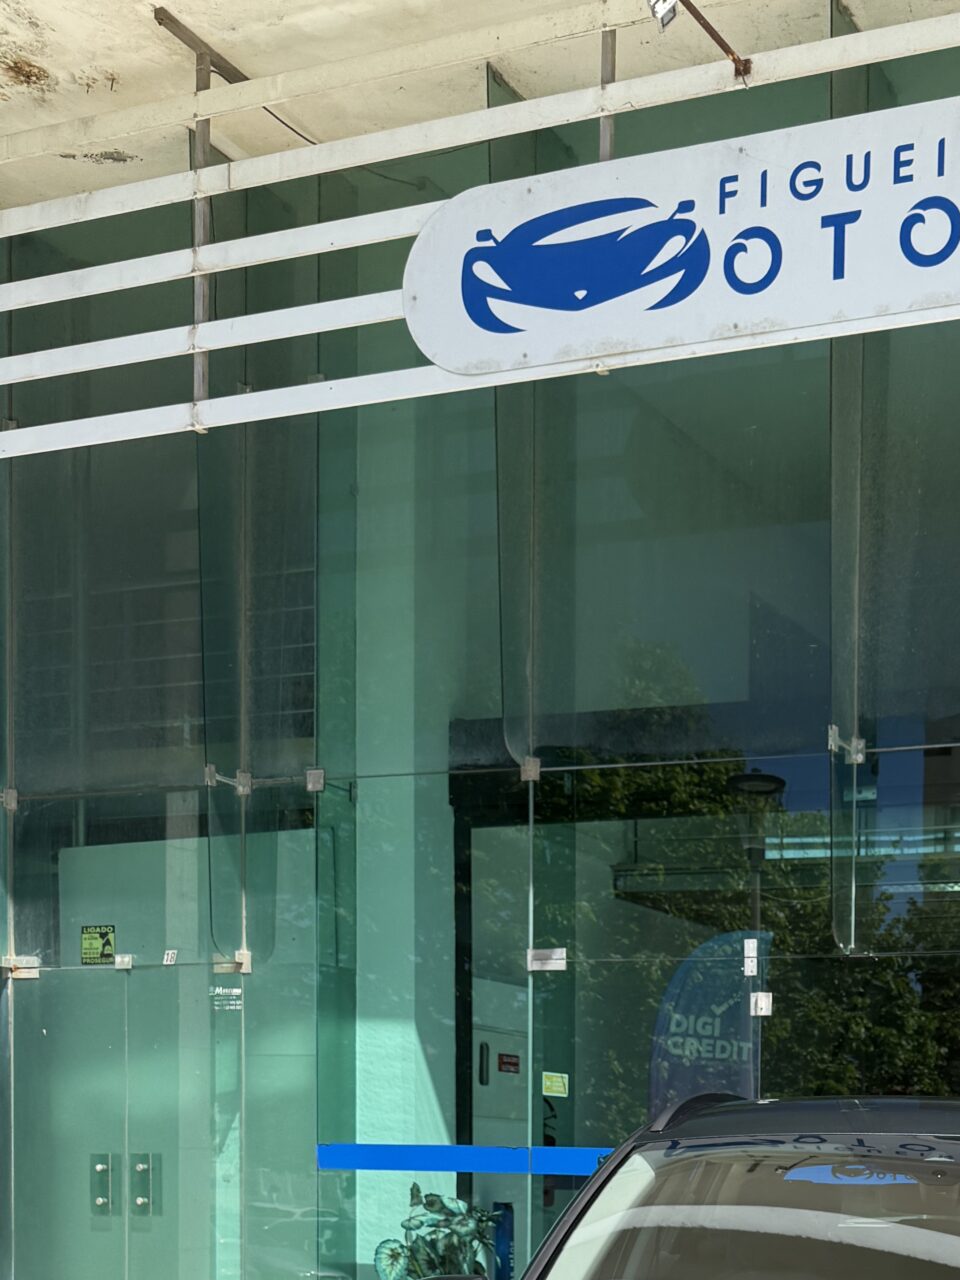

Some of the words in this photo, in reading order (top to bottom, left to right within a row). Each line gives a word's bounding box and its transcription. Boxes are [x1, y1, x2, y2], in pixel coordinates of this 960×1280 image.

[83, 926, 113, 934] LIGADO
[165, 951, 176, 963] 18
[669, 1012, 721, 1037] DIGI
[667, 1035, 753, 1061] CREDIT
